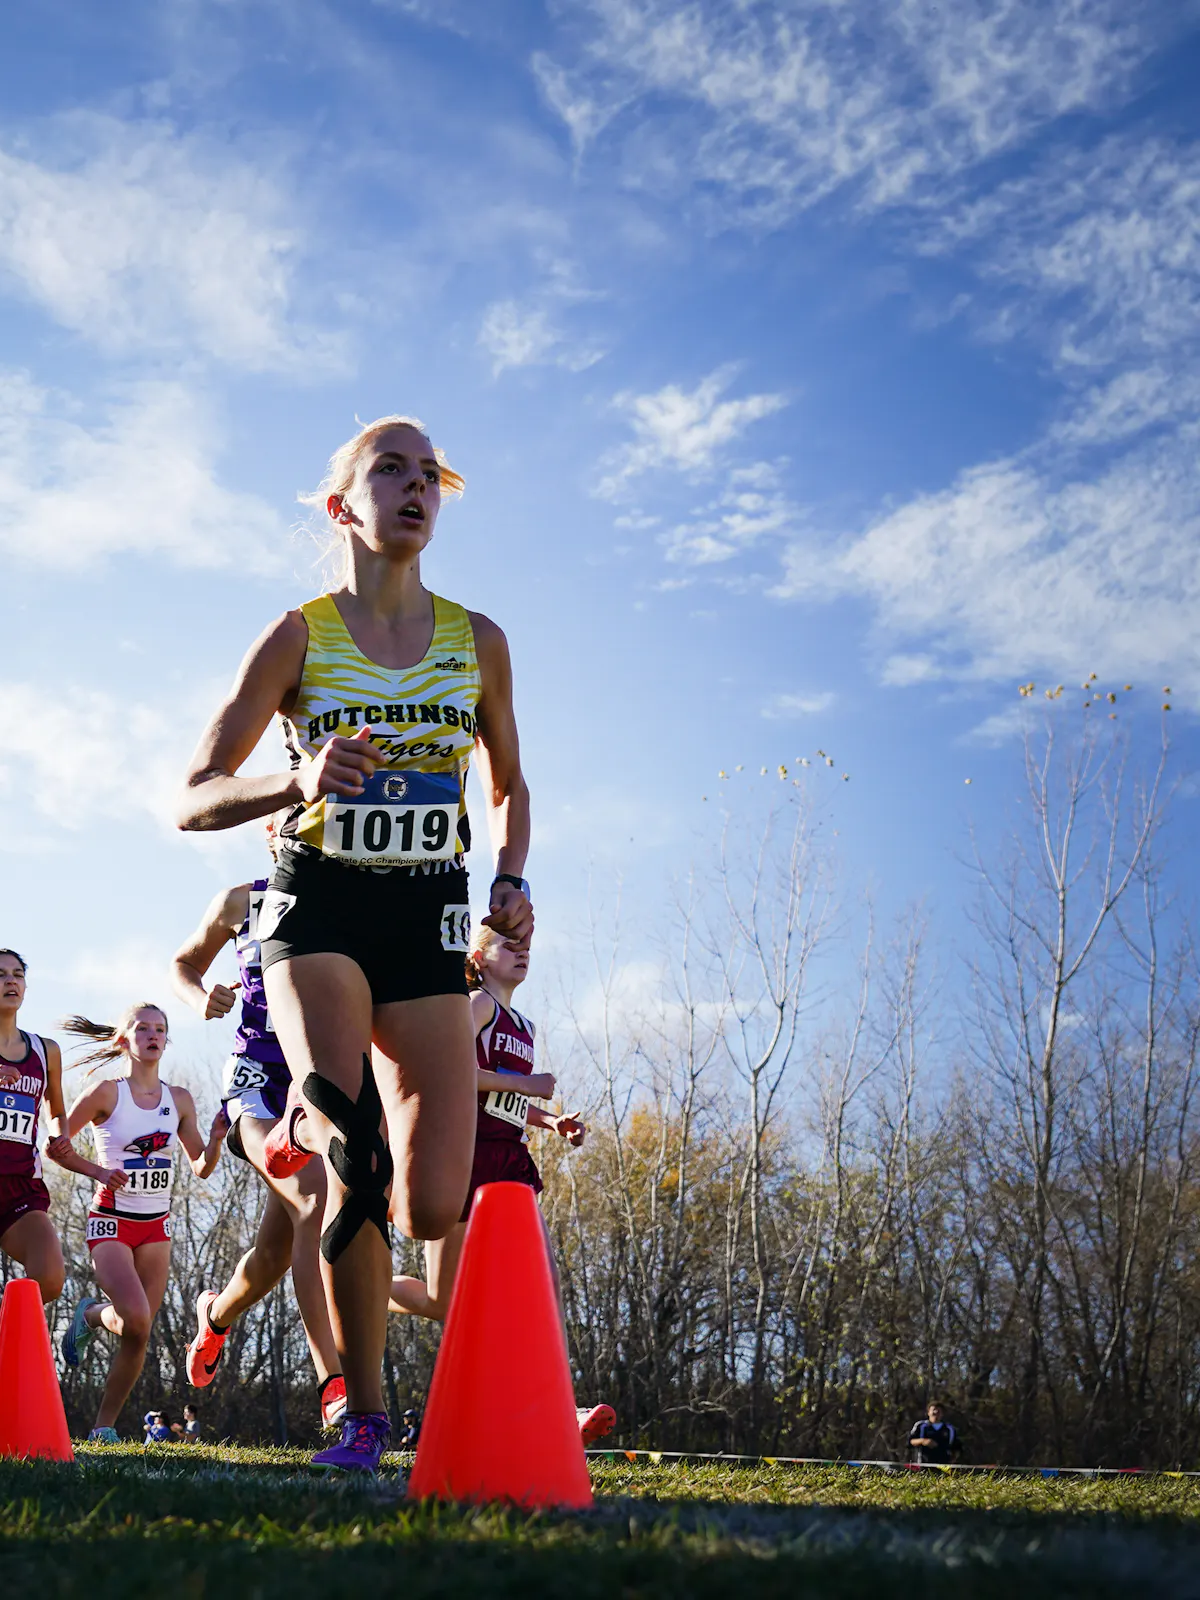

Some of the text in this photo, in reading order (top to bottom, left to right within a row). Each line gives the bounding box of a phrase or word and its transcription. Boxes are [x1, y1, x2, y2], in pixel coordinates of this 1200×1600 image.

[335, 809, 449, 852] 1019
[360, 857, 373, 865] CC
[232, 1065, 265, 1088] 52
[495, 1091, 527, 1120] 1016
[128, 1170, 169, 1189] 1189
